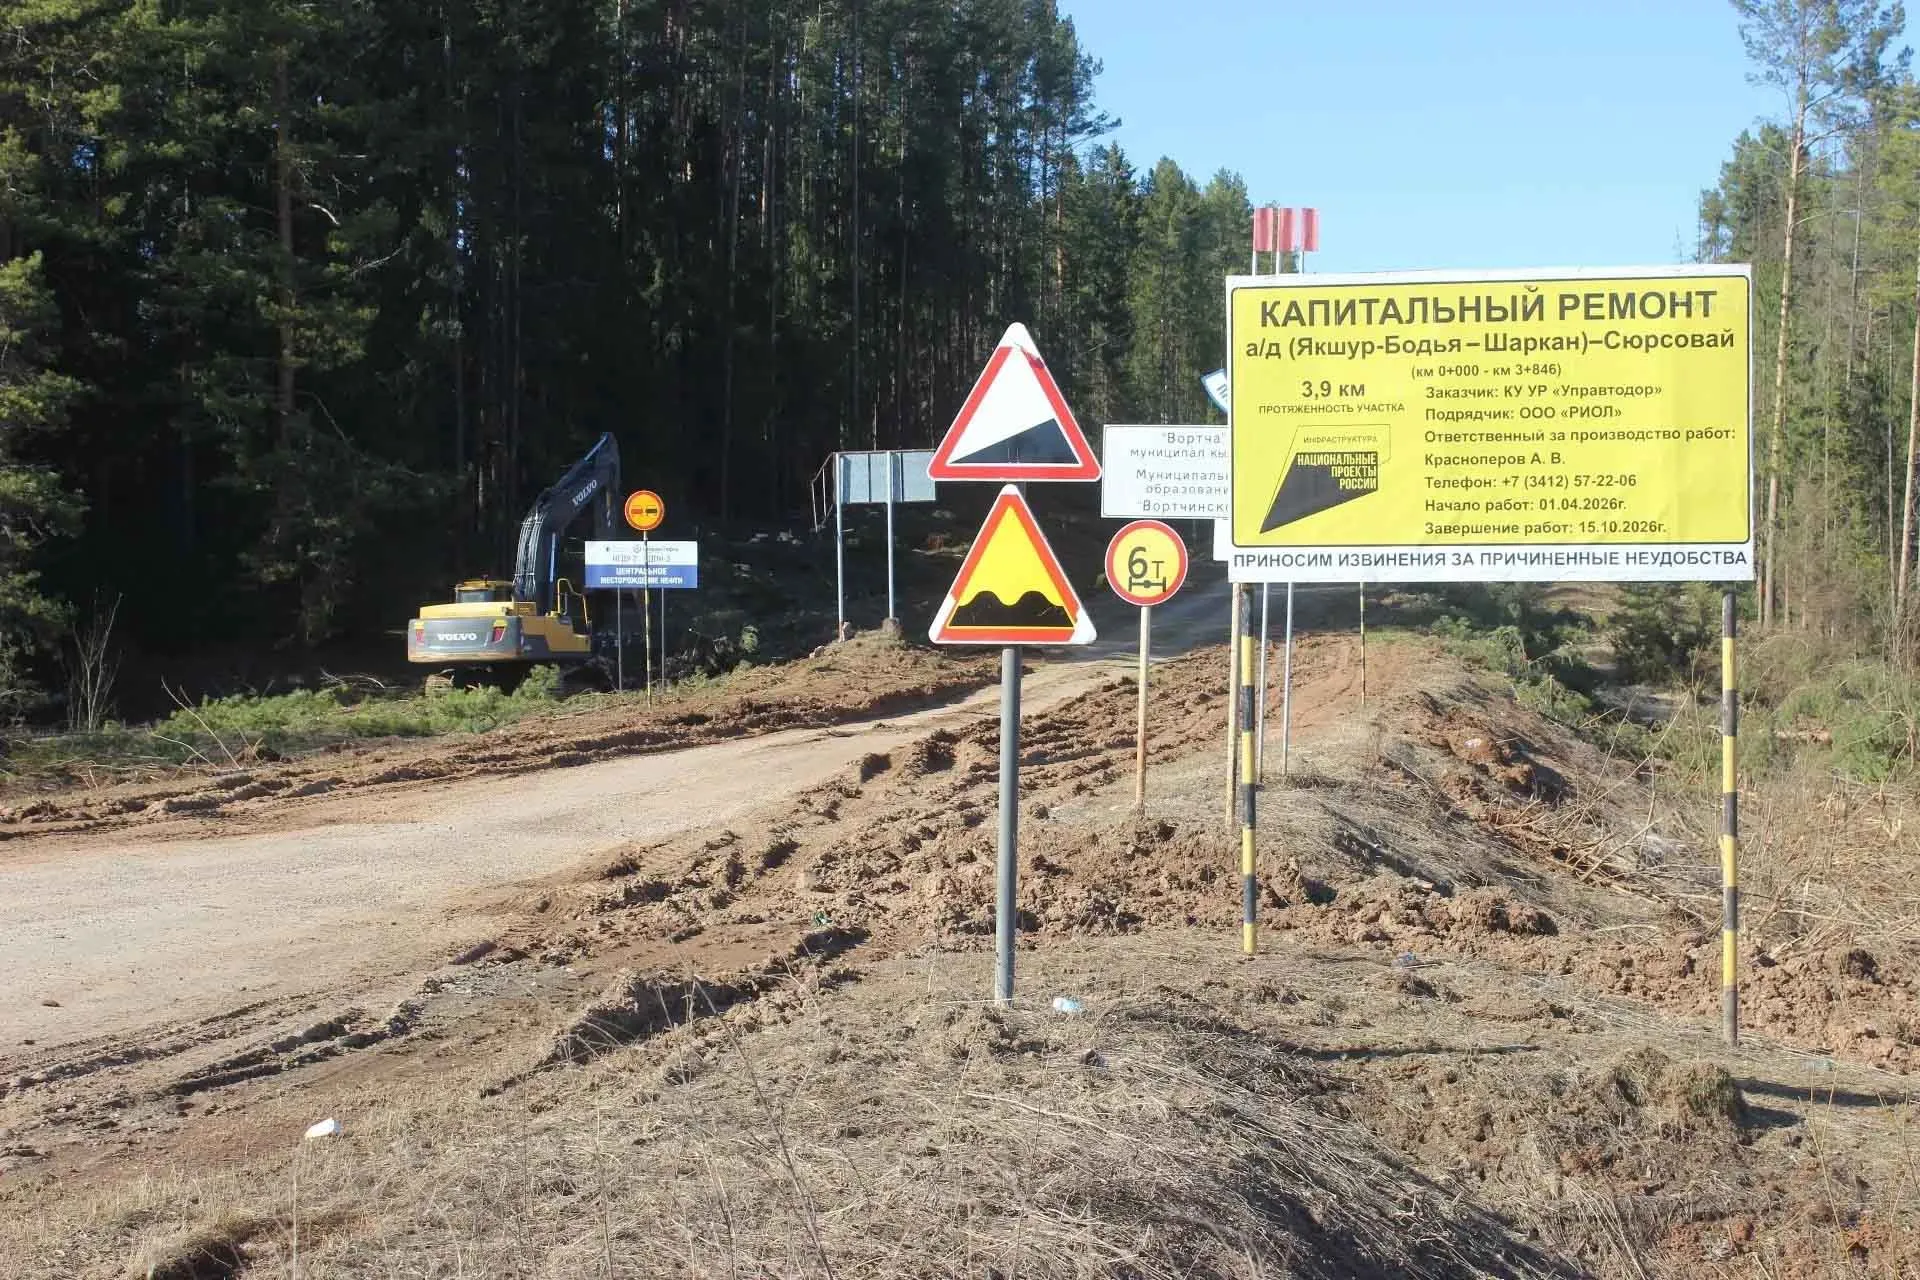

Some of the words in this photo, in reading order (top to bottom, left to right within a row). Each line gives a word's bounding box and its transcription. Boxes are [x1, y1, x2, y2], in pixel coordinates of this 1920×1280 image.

[1261, 286, 1544, 327] КАПИТАЛЬНЫЙ
[1559, 291, 1717, 320] РЕМОНТ
[1246, 338, 1281, 359] а/д
[1412, 367, 1433, 379] (км
[1439, 365, 1479, 376] 0+000
[1493, 368, 1510, 376] км
[1516, 363, 1561, 376] 3+846)
[1302, 380, 1331, 400] 3,9
[1339, 384, 1364, 396] км
[1426, 387, 1498, 400] Заказчик:
[1504, 385, 1522, 397] КУ
[1528, 385, 1547, 397] УР
[1553, 384, 1661, 398] «Управтодор»
[1259, 404, 1354, 414] ПРОТЯЖЕННОСТЬ
[1357, 403, 1404, 412] УЧАСТКА
[1426, 408, 1514, 422] Подрядчик:
[1520, 407, 1555, 419] ООО
[1561, 406, 1621, 418] «РИОЛ»
[1425, 431, 1544, 442] Ответственный
[1550, 432, 1565, 441] за
[1571, 430, 1680, 443] производство
[1686, 427, 1735, 442] работ:
[1297, 453, 1377, 467] НАЦИОНАЛЬНЫЕ
[1425, 454, 1525, 468] Красноперов
[1531, 453, 1545, 464] А.
[1551, 452, 1565, 464] В.
[1331, 466, 1377, 478] ПРОЕКТЫ
[1339, 478, 1377, 490] РОССИИ
[1425, 476, 1496, 489] Телефон:
[1502, 476, 1519, 487] +7
[1525, 475, 1568, 489] (3412)
[1574, 474, 1636, 487] 57-22-06
[571, 479, 597, 505] VOLVO
[1426, 500, 1480, 511] Начало
[1486, 498, 1533, 511] работ:
[1540, 498, 1627, 510] 01.04.2026г.
[1425, 522, 1519, 536] Завершение
[1525, 522, 1572, 536] работ:
[1579, 521, 1667, 533] 15.10.2026г.
[1234, 554, 1332, 567] ПРИНОСИМ
[1339, 553, 1445, 567] ИЗВИНЕНИЯ
[1452, 553, 1474, 566] ЗА
[1481, 552, 1619, 565] ПРИЧИНЕННЫЕ
[1626, 551, 1747, 566] НЕУДОБСТВА
[600, 576, 658, 585] МЕСТОРОЖДНИЕ
[437, 632, 478, 641] VOLVO
